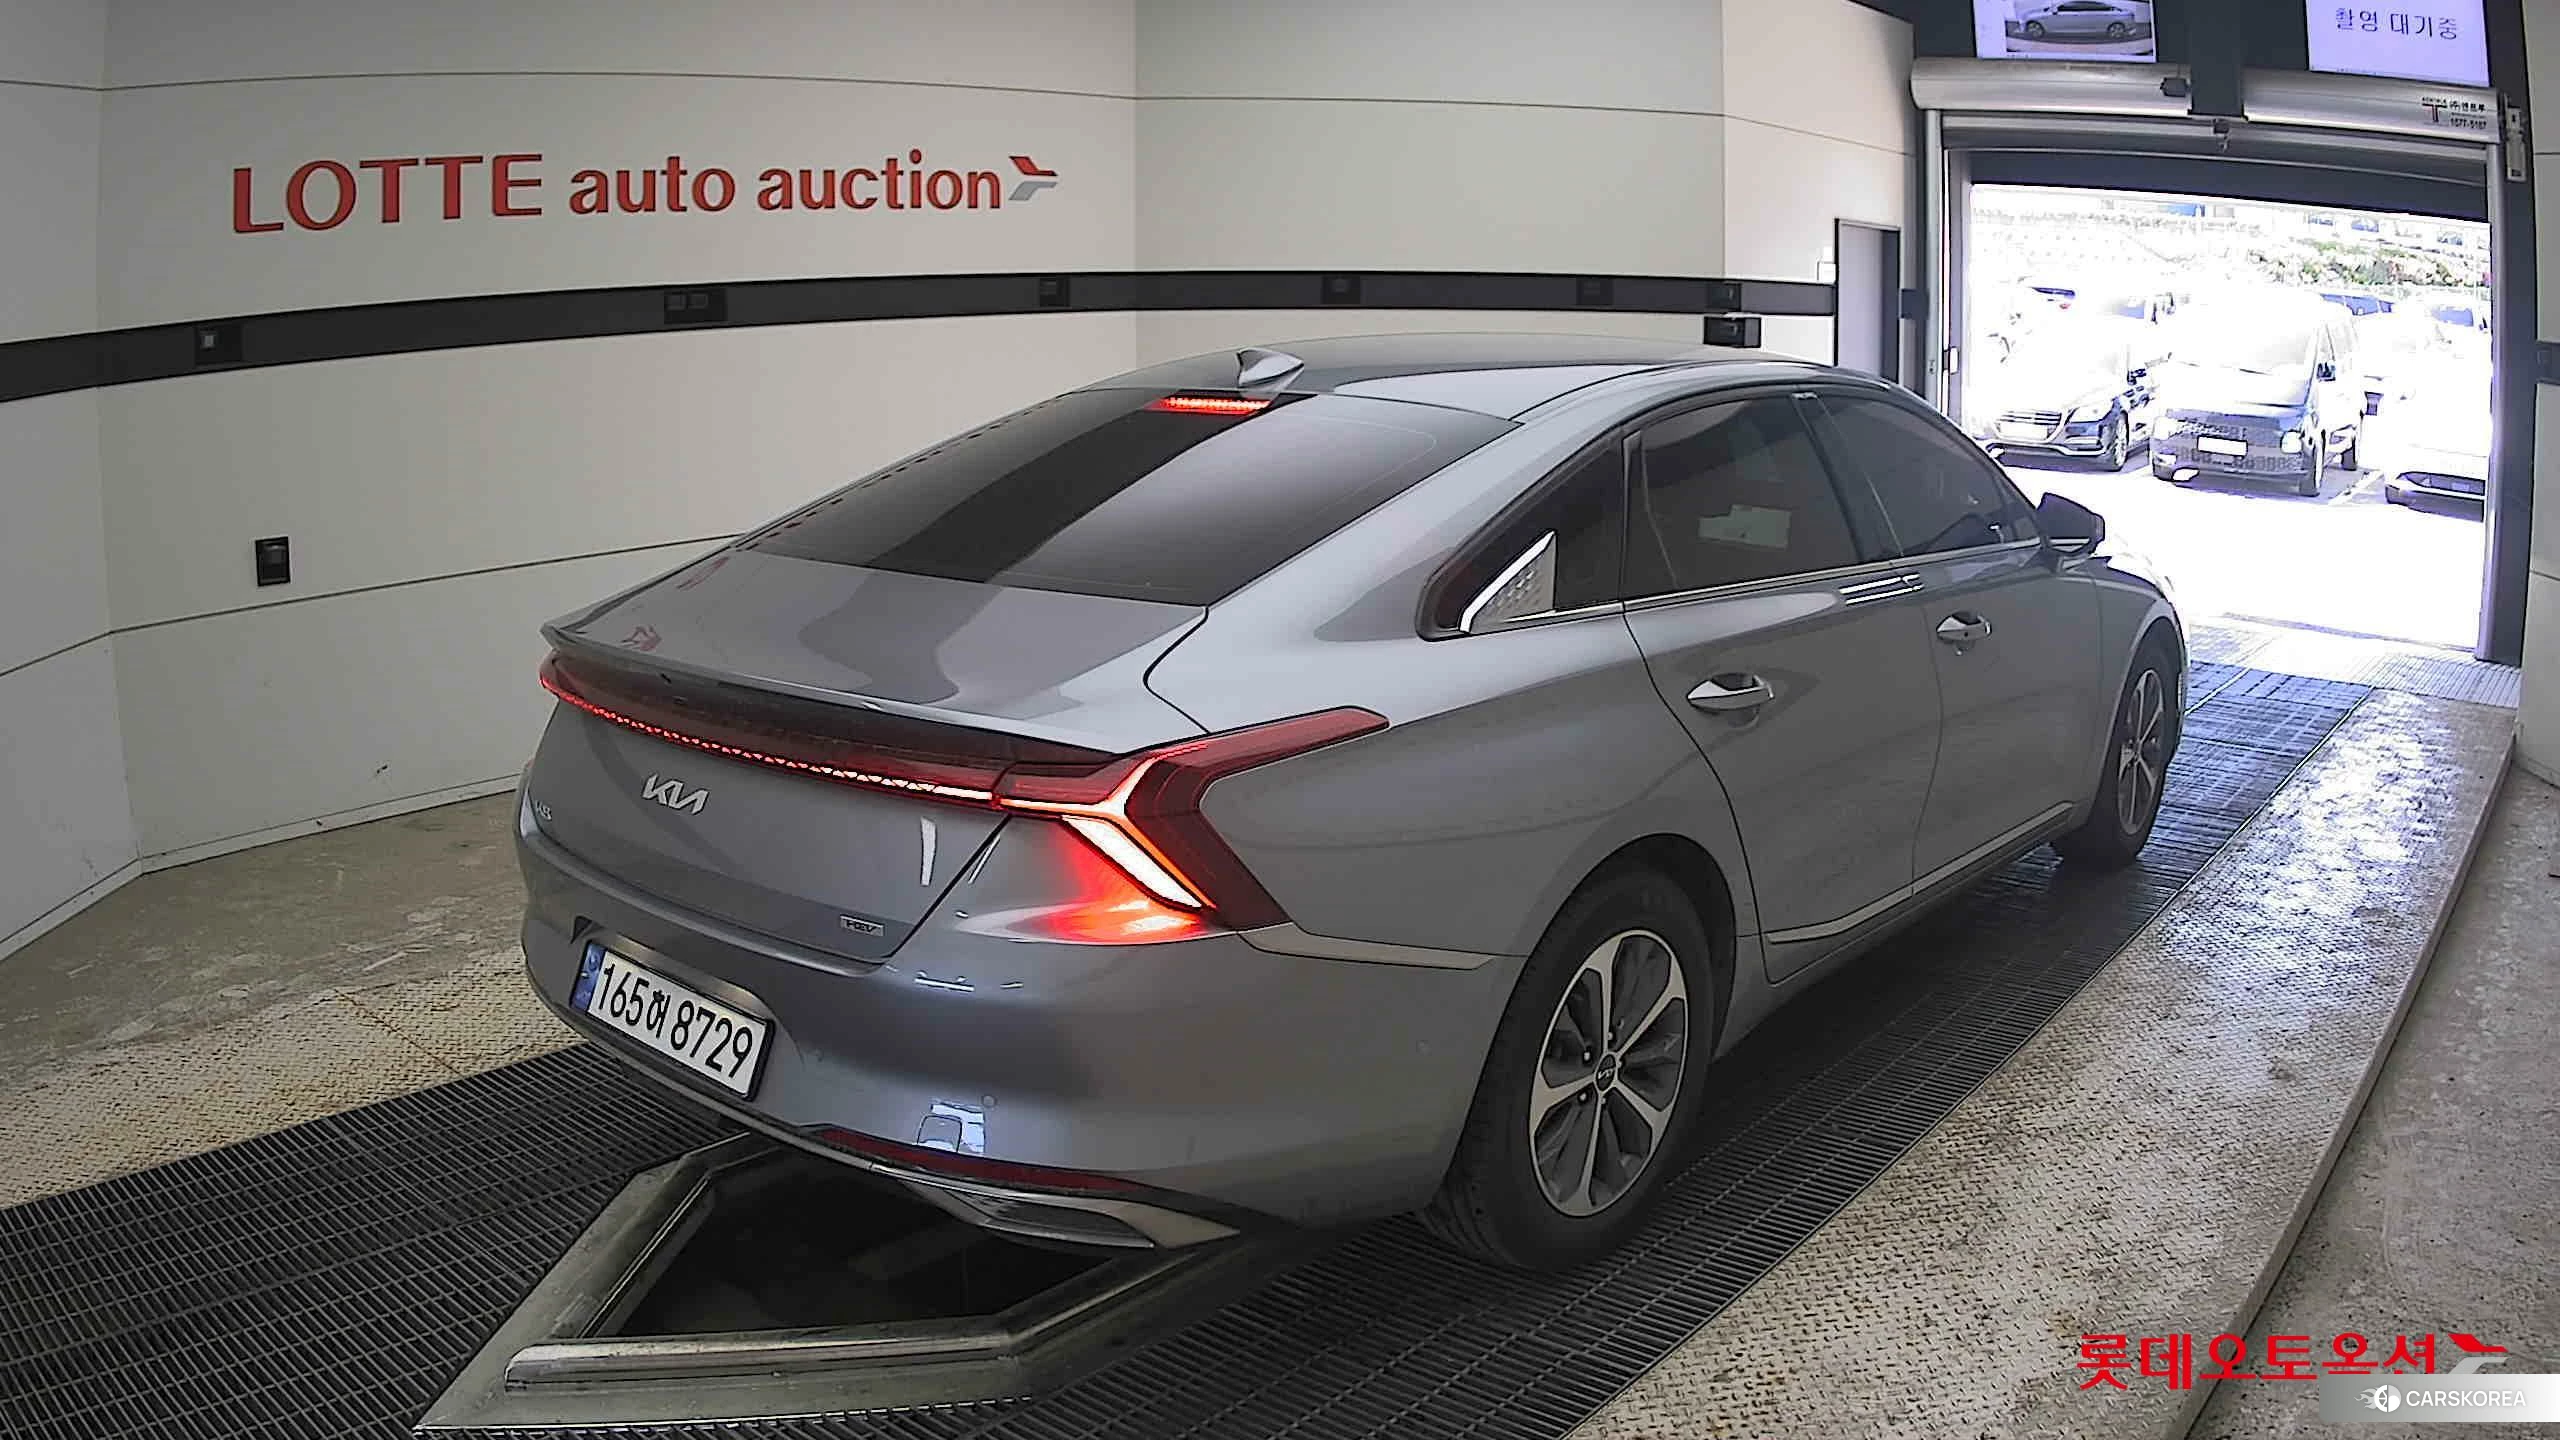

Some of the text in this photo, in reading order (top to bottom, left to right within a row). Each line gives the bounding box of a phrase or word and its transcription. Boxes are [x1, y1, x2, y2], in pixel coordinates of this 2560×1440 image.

[2336, 7, 2457, 40] 촬영 대기중
[233, 148, 1001, 233] LOTTE auto auction
[642, 773, 709, 815] KIA
